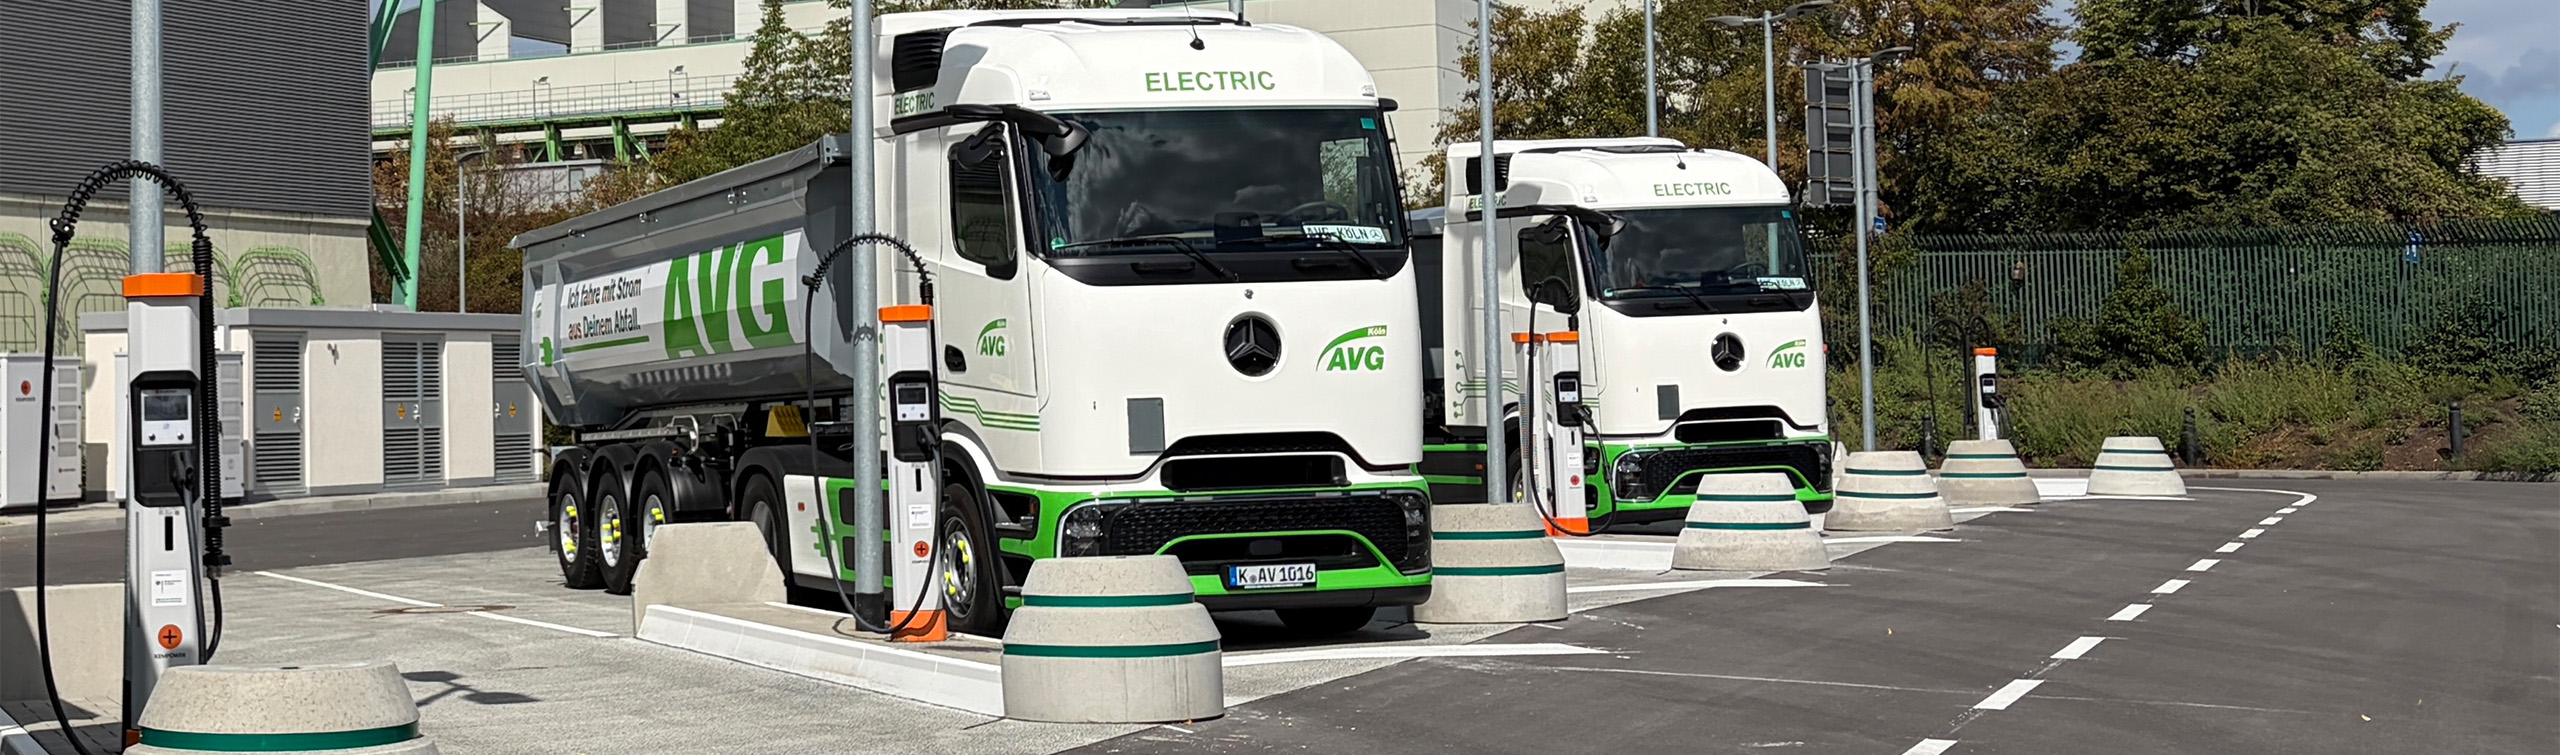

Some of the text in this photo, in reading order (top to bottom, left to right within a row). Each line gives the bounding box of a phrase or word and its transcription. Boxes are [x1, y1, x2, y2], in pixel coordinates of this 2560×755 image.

[1145, 71, 1276, 92] ELECTRIC
[894, 92, 935, 115] ELECTRIC
[1653, 182, 1731, 196] ELECTRIC
[1337, 227, 1369, 240] KÖLN
[567, 276, 642, 309] Ich fahre mit Strom
[663, 235, 797, 359] AVG
[568, 307, 641, 340] aus Deinem Abfall.
[980, 335, 1005, 357] AVG
[1326, 345, 1385, 371] AVG
[1771, 352, 1805, 369] AVG
[1239, 565, 1314, 584] K AV 1016
